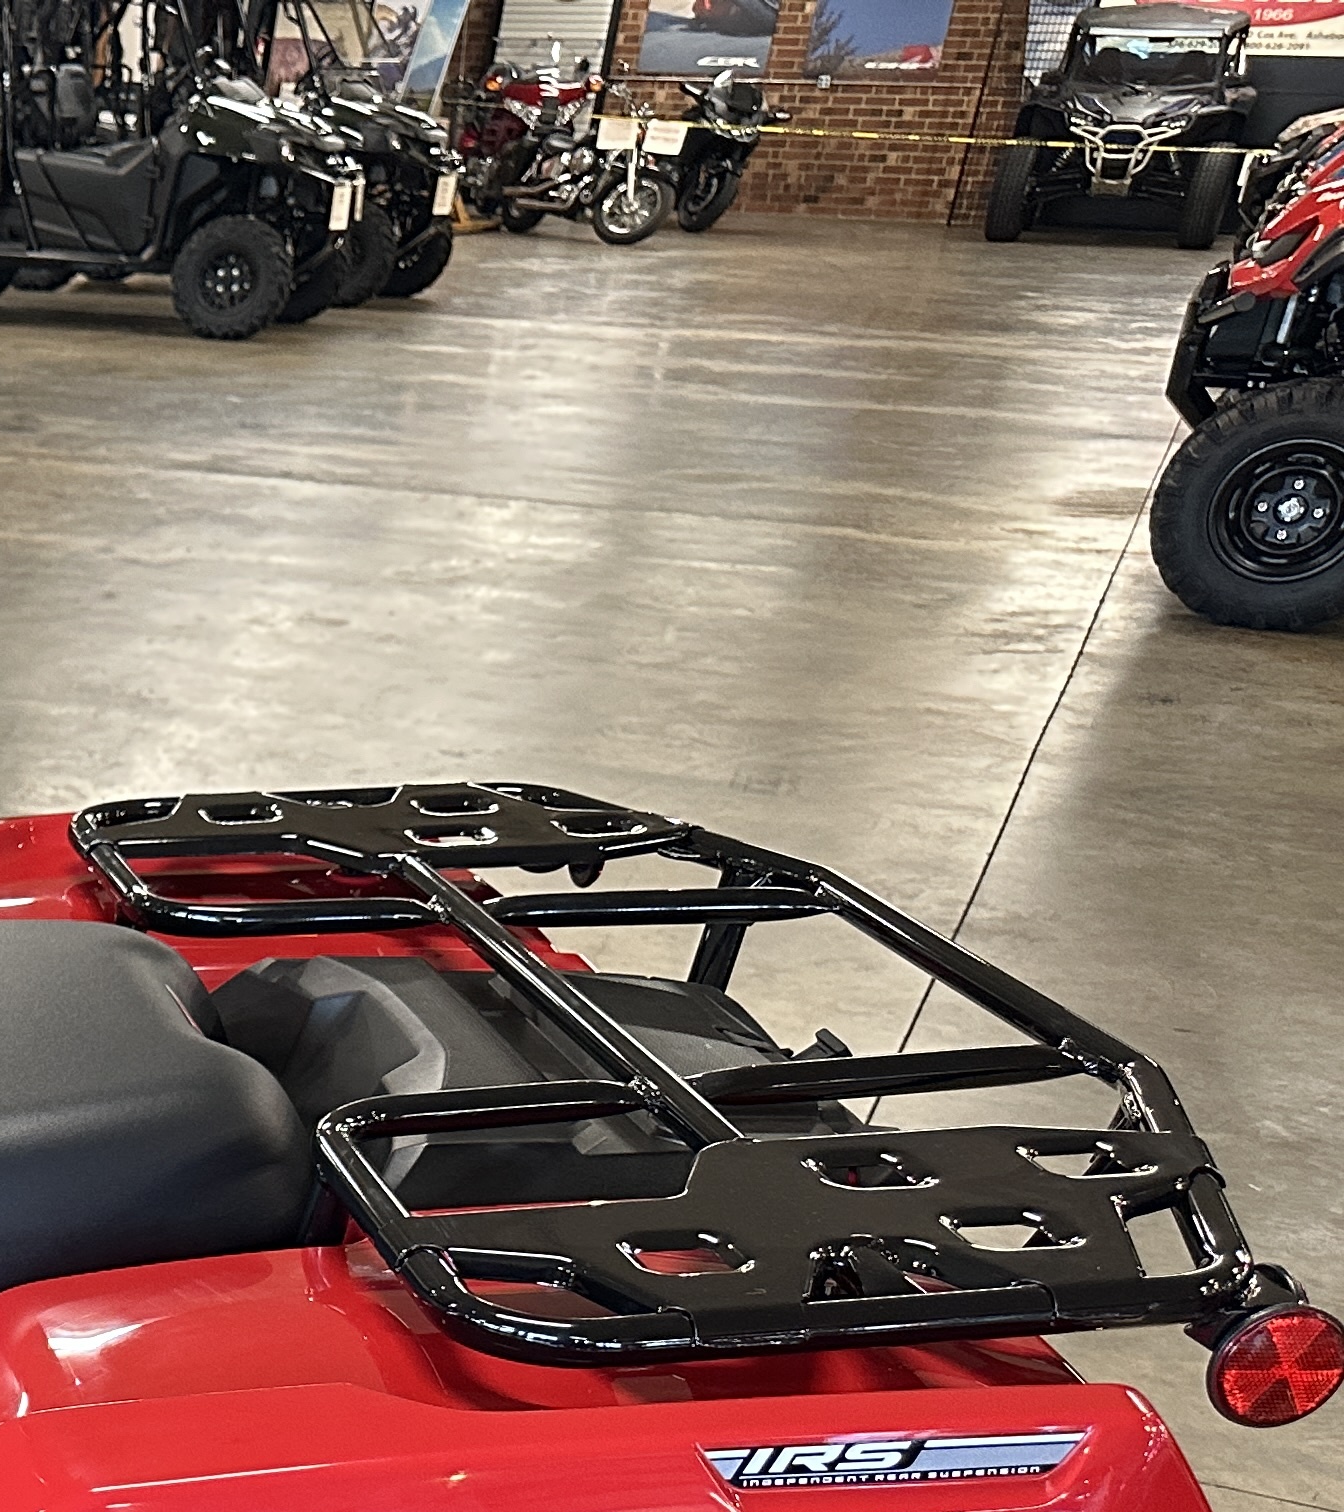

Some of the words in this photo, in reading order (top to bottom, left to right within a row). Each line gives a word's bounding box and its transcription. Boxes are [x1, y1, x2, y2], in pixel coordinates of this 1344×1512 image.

[1254, 8, 1294, 21] 1966
[742, 1440, 912, 1474] IRS
[742, 1474, 868, 1488] INDEPENDENT
[875, 1471, 921, 1482] REAR
